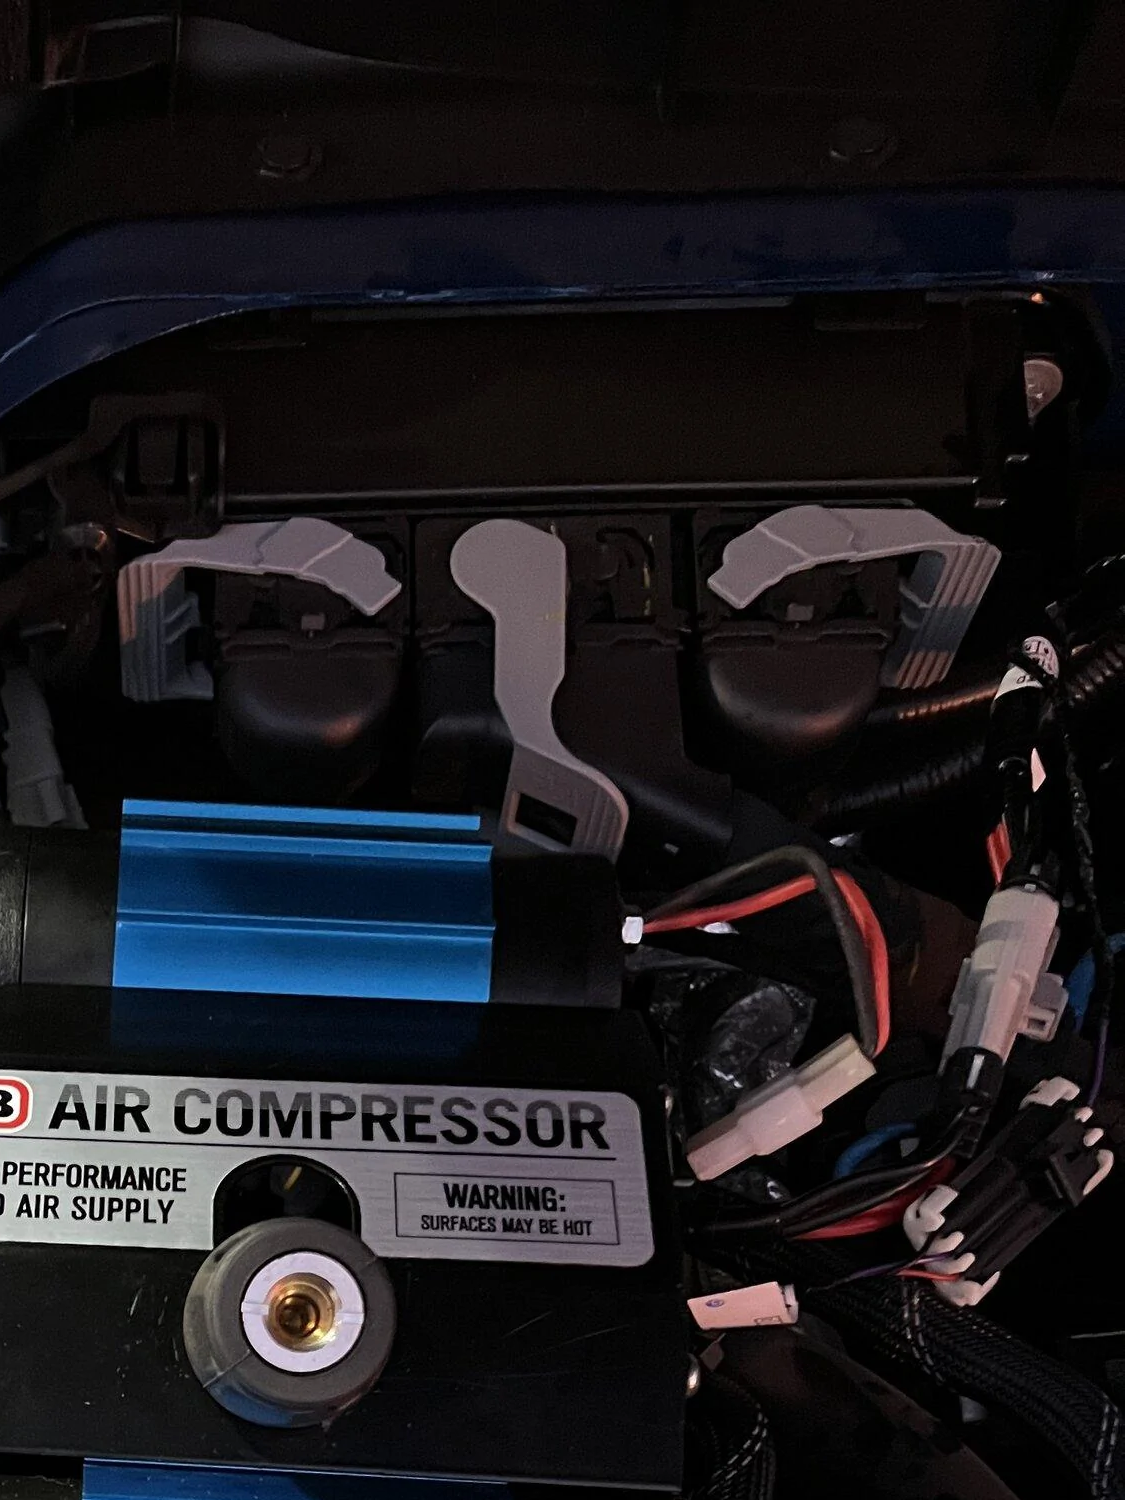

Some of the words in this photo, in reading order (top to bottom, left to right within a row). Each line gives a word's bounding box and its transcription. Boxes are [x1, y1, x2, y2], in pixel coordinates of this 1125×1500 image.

[48, 1083, 152, 1133] AIR
[173, 1087, 610, 1150] COMPRESSOR
[1, 1161, 187, 1192] PERFORMANCE
[15, 1194, 59, 1219] AIR
[71, 1196, 175, 1224] SUPPLY
[443, 1182, 566, 1213] WARNING:
[421, 1215, 496, 1233] SURFACES
[502, 1217, 537, 1234] MAY
[539, 1219, 558, 1235] BE
[563, 1219, 593, 1236] HOT
